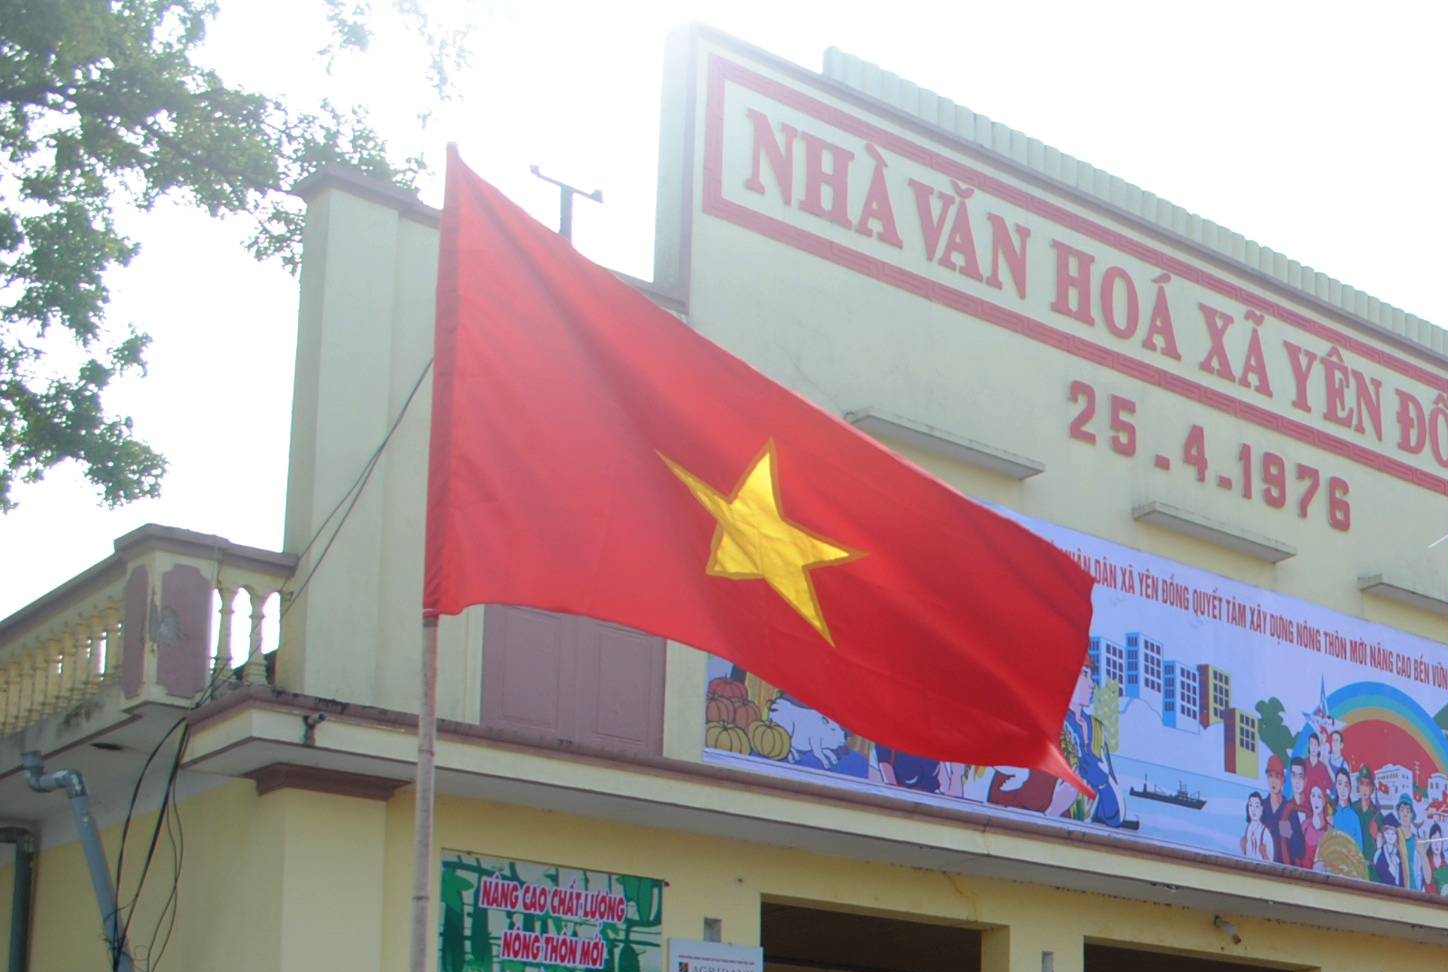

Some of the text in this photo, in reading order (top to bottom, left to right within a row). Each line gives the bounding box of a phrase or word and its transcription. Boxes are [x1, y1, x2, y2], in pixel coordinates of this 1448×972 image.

[744, 108, 903, 249] NHÀ
[908, 178, 1031, 300] VĂN
[1050, 238, 1182, 361] HOÁ
[1197, 301, 1273, 399] XÃ
[1283, 340, 1384, 442] YÊN
[1094, 556, 1117, 590] DÂN
[1120, 564, 1136, 596] XÃ
[1138, 569, 1160, 602] YÊN
[1193, 587, 1223, 622] QUYẾT
[1225, 596, 1247, 629] TÂM
[1249, 604, 1267, 635] XÂY
[1296, 620, 1322, 654] NÔNG
[1323, 630, 1348, 661] THÔN
[1369, 642, 1394, 674] NÂNG
[1396, 653, 1411, 680] CAO
[481, 872, 626, 928] NÂNG CAO CHẤT LƯỢNG
[501, 925, 605, 967] NÔNG THÔN MỚI
